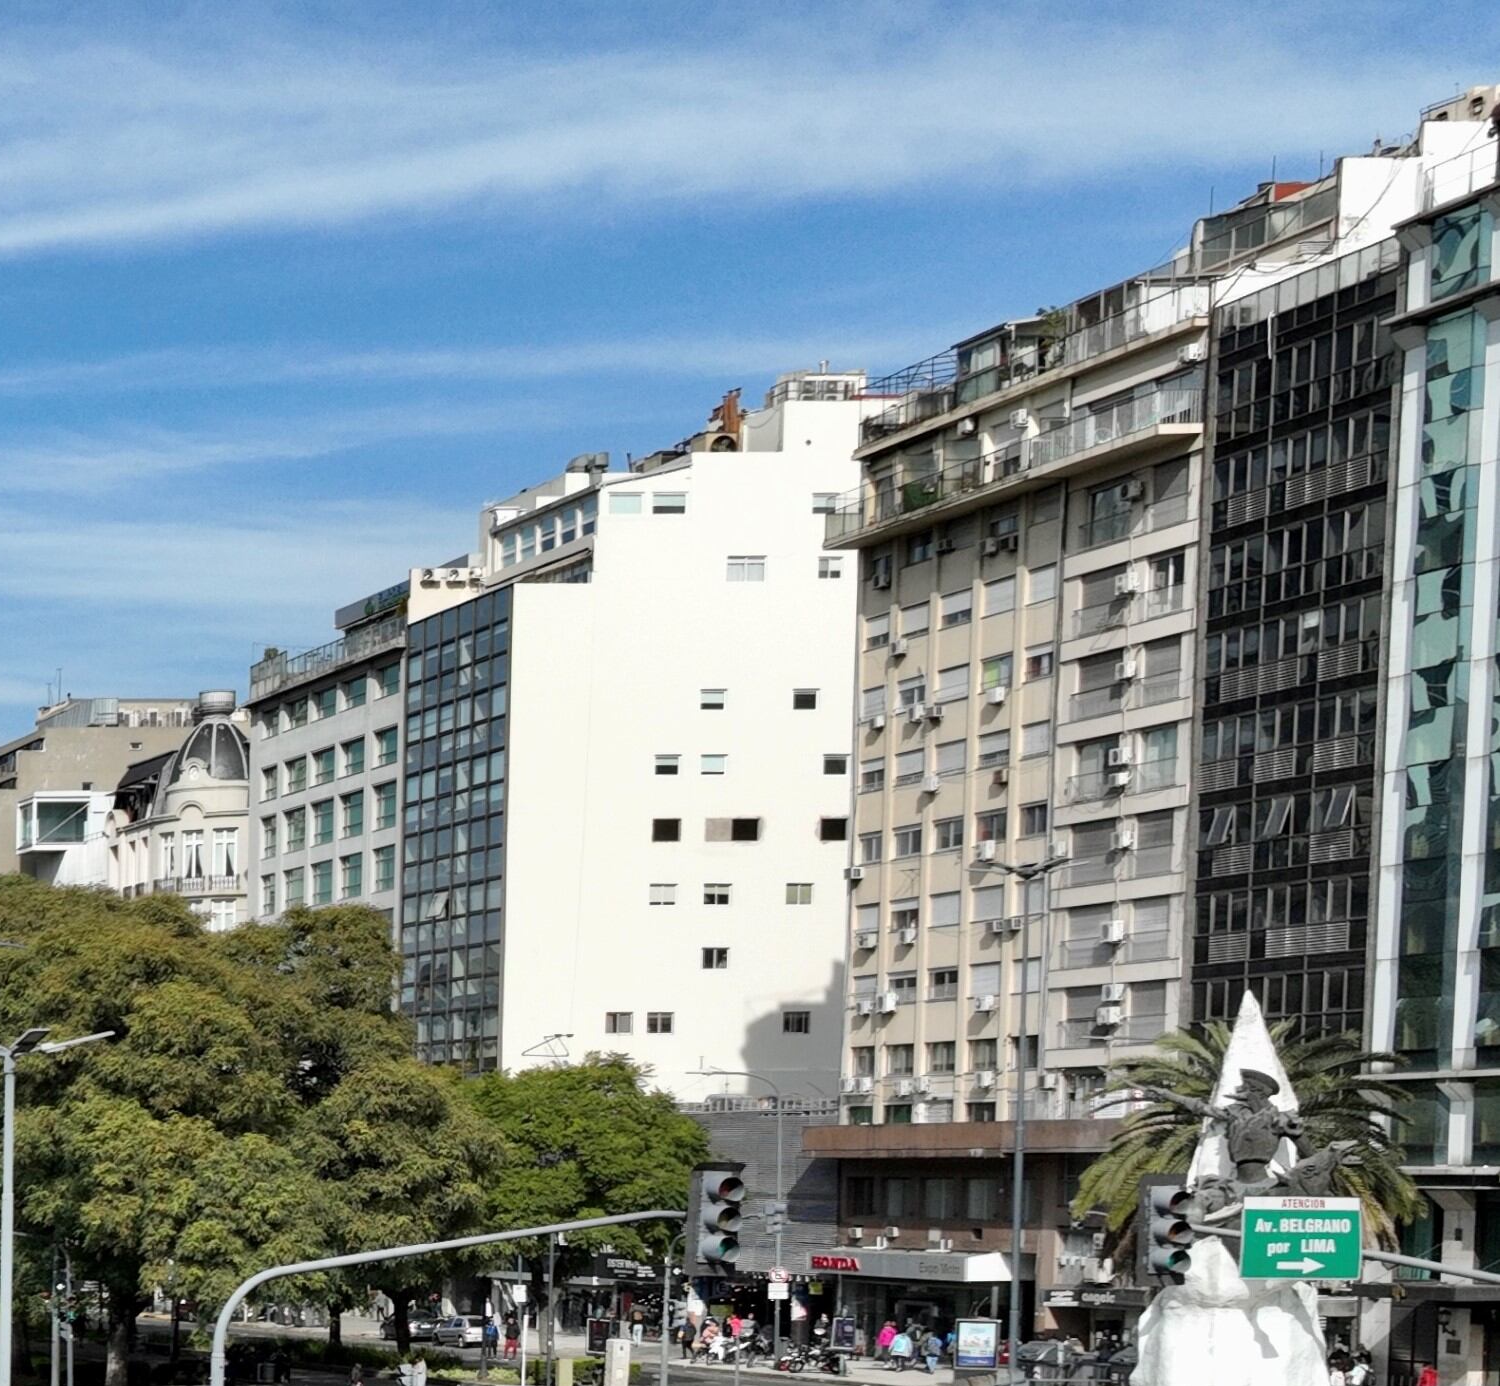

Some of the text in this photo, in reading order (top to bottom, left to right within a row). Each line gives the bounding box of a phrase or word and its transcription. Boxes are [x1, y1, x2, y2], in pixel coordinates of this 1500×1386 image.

[1255, 1218, 1351, 1232] Av. BELGRANO
[1267, 1239, 1336, 1257] por LIMA
[812, 1256, 859, 1271] HONDA
